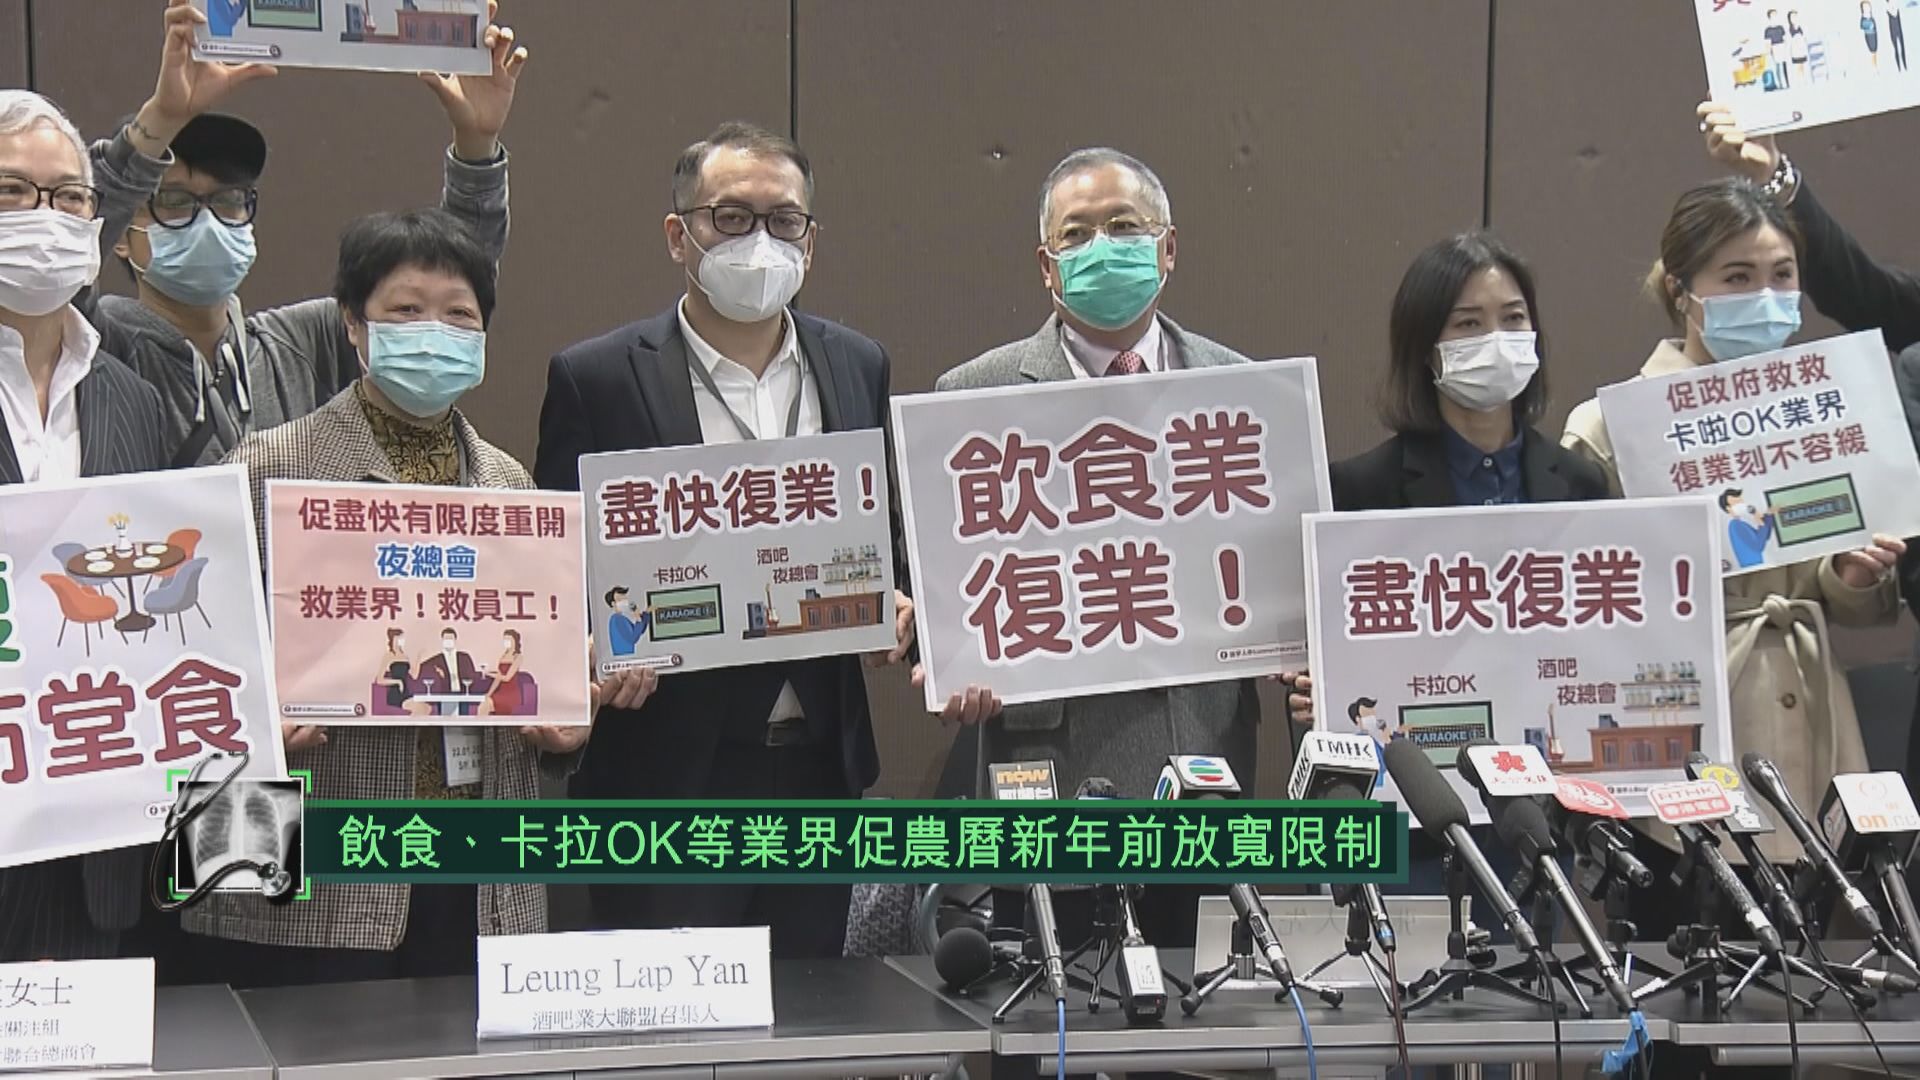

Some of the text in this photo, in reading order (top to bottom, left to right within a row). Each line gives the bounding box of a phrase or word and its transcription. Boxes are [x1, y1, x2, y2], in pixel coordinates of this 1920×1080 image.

[1666, 353, 1831, 412] 促政府救救
[1666, 389, 1846, 451] 卡啦OK業界
[949, 411, 1271, 538] 飲食業
[1669, 424, 1869, 492] 復業刻不容緩
[298, 496, 566, 539] 促盡快有限度重開
[601, 463, 876, 540] 盡快復業！
[376, 542, 477, 580] 夜總會
[756, 547, 789, 565] 酒吧
[653, 564, 710, 585] 卡拉OK
[772, 563, 820, 585] 夜總會
[299, 584, 560, 622] 救業界！救員工！
[964, 541, 1247, 661] 復業！
[1346, 549, 1693, 635] 盡快復業！
[659, 606, 701, 621] KARAOKE
[1406, 674, 1478, 698] 卡拉OK
[1536, 657, 1578, 680] 酒吧
[1556, 682, 1617, 707] 夜總會
[0, 658, 249, 784] 堂食
[1414, 731, 1467, 744] KARAOKE
[1315, 738, 1373, 758] TMHK
[996, 769, 1050, 785] now
[0, 976, 74, 1008] 女士
[500, 955, 750, 996] Leung Lap Yan
[531, 1002, 721, 1031] 酒吧業大聯盟召集人
